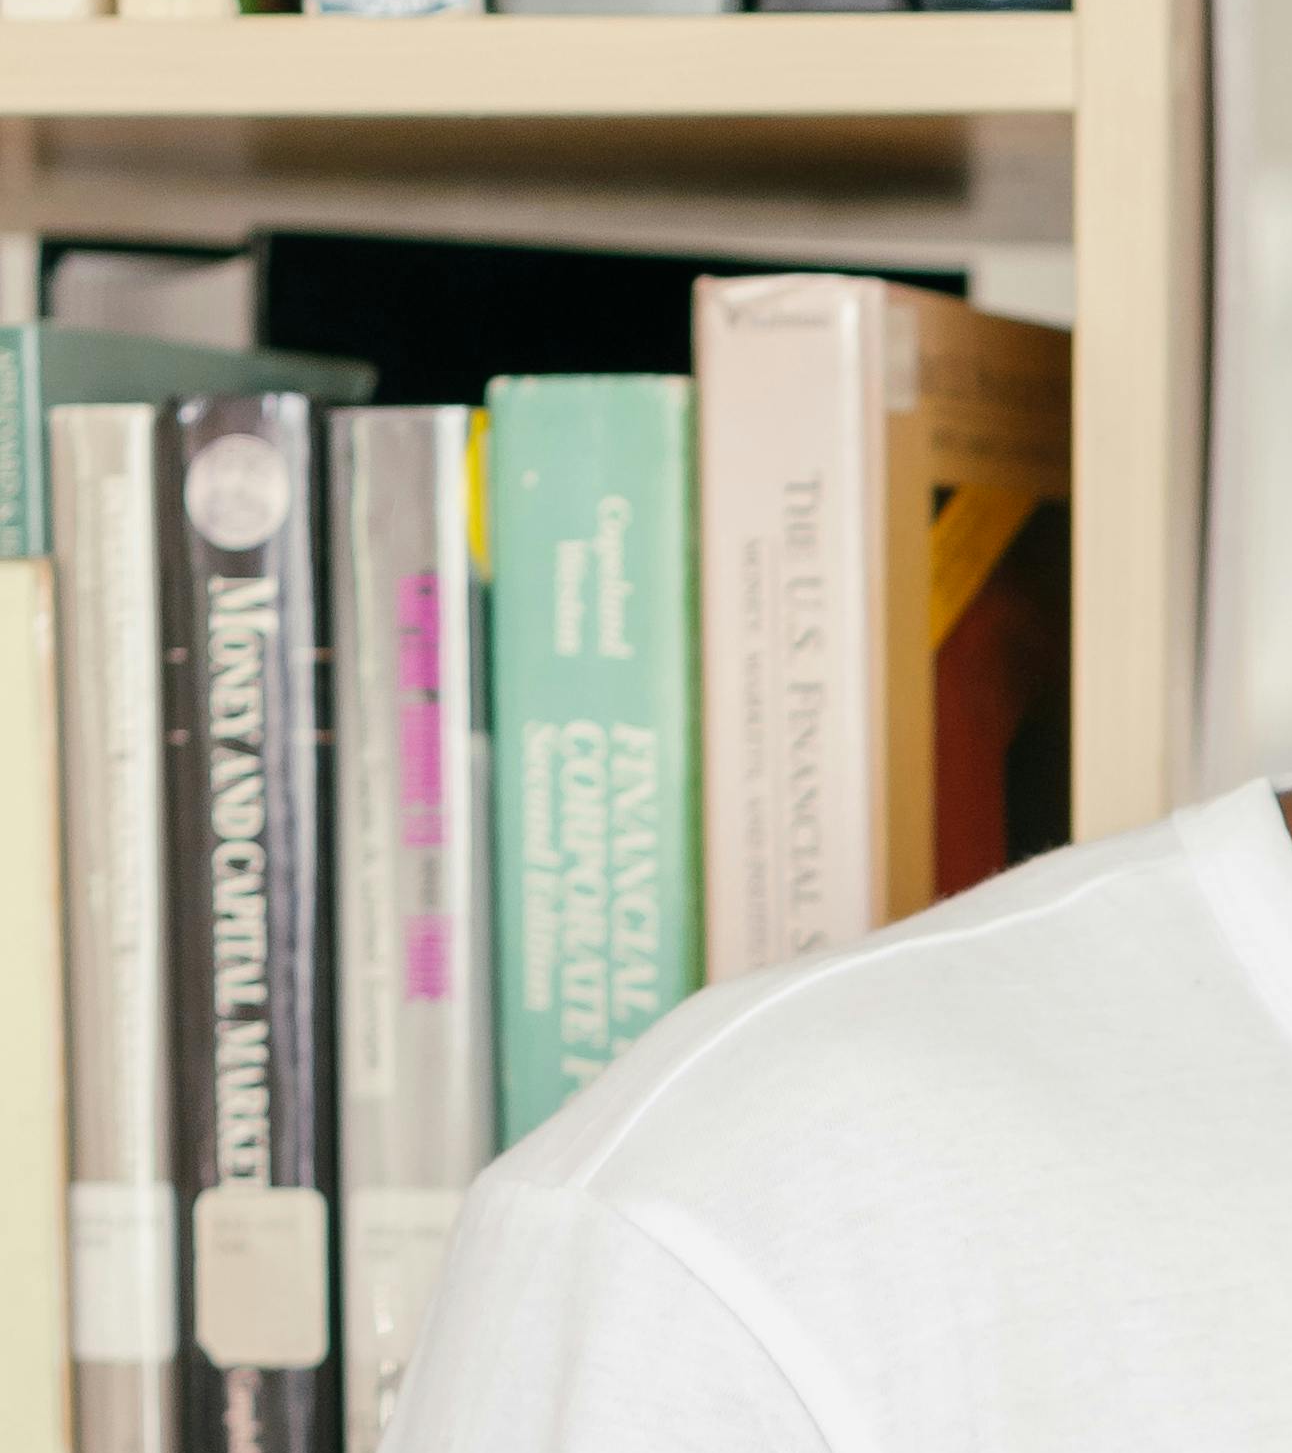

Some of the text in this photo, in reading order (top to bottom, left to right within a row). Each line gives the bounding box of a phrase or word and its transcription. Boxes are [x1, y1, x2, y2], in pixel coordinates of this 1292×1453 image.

[209, 575, 279, 742] MONEY
[554, 538, 588, 657] Weston
[595, 495, 634, 660] Copeland
[783, 474, 826, 908] THE U.S. FINANCIAL
[210, 747, 268, 838] AND
[522, 721, 561, 1012] Second Edition
[610, 720, 659, 1023] FINANCIAL
[212, 845, 268, 1016] CAPITAL
[560, 717, 608, 1046] CORPORATE
